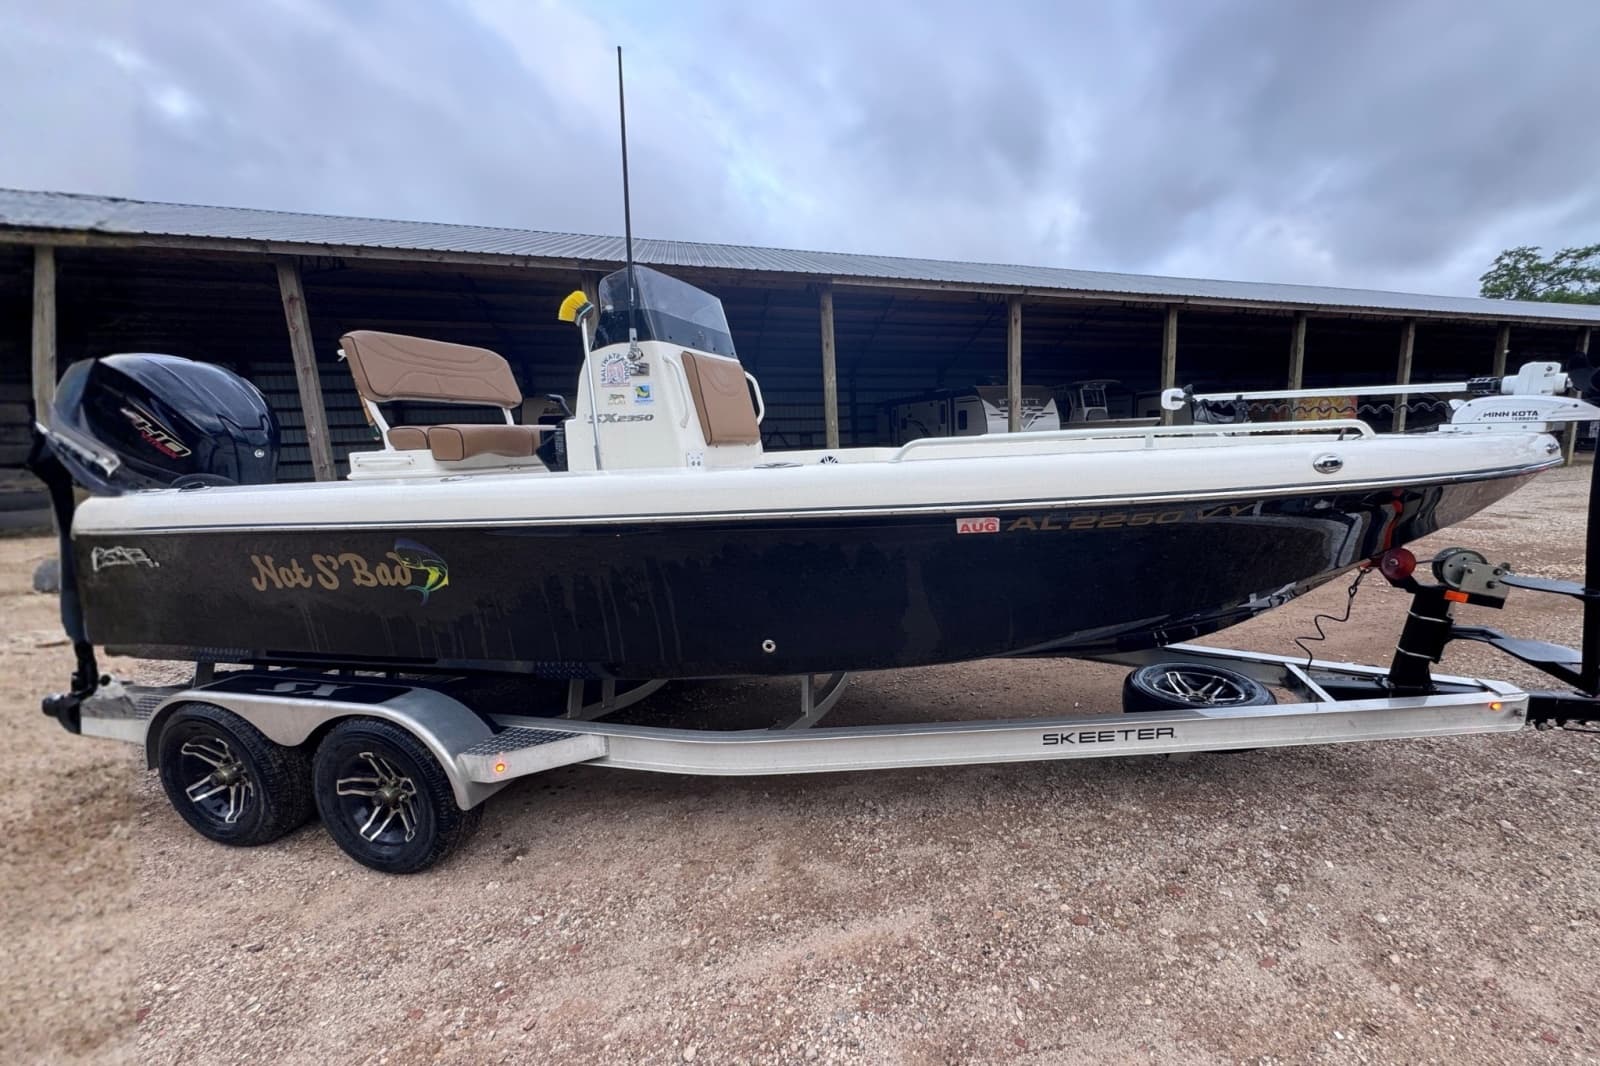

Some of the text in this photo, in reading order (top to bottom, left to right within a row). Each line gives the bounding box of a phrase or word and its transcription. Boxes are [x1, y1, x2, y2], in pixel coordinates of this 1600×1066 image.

[587, 412, 654, 424] SX2350
[960, 521, 997, 532] AUG
[1006, 515, 1062, 531] AL
[250, 554, 313, 592] Not
[1042, 727, 1175, 746] SKEETER
